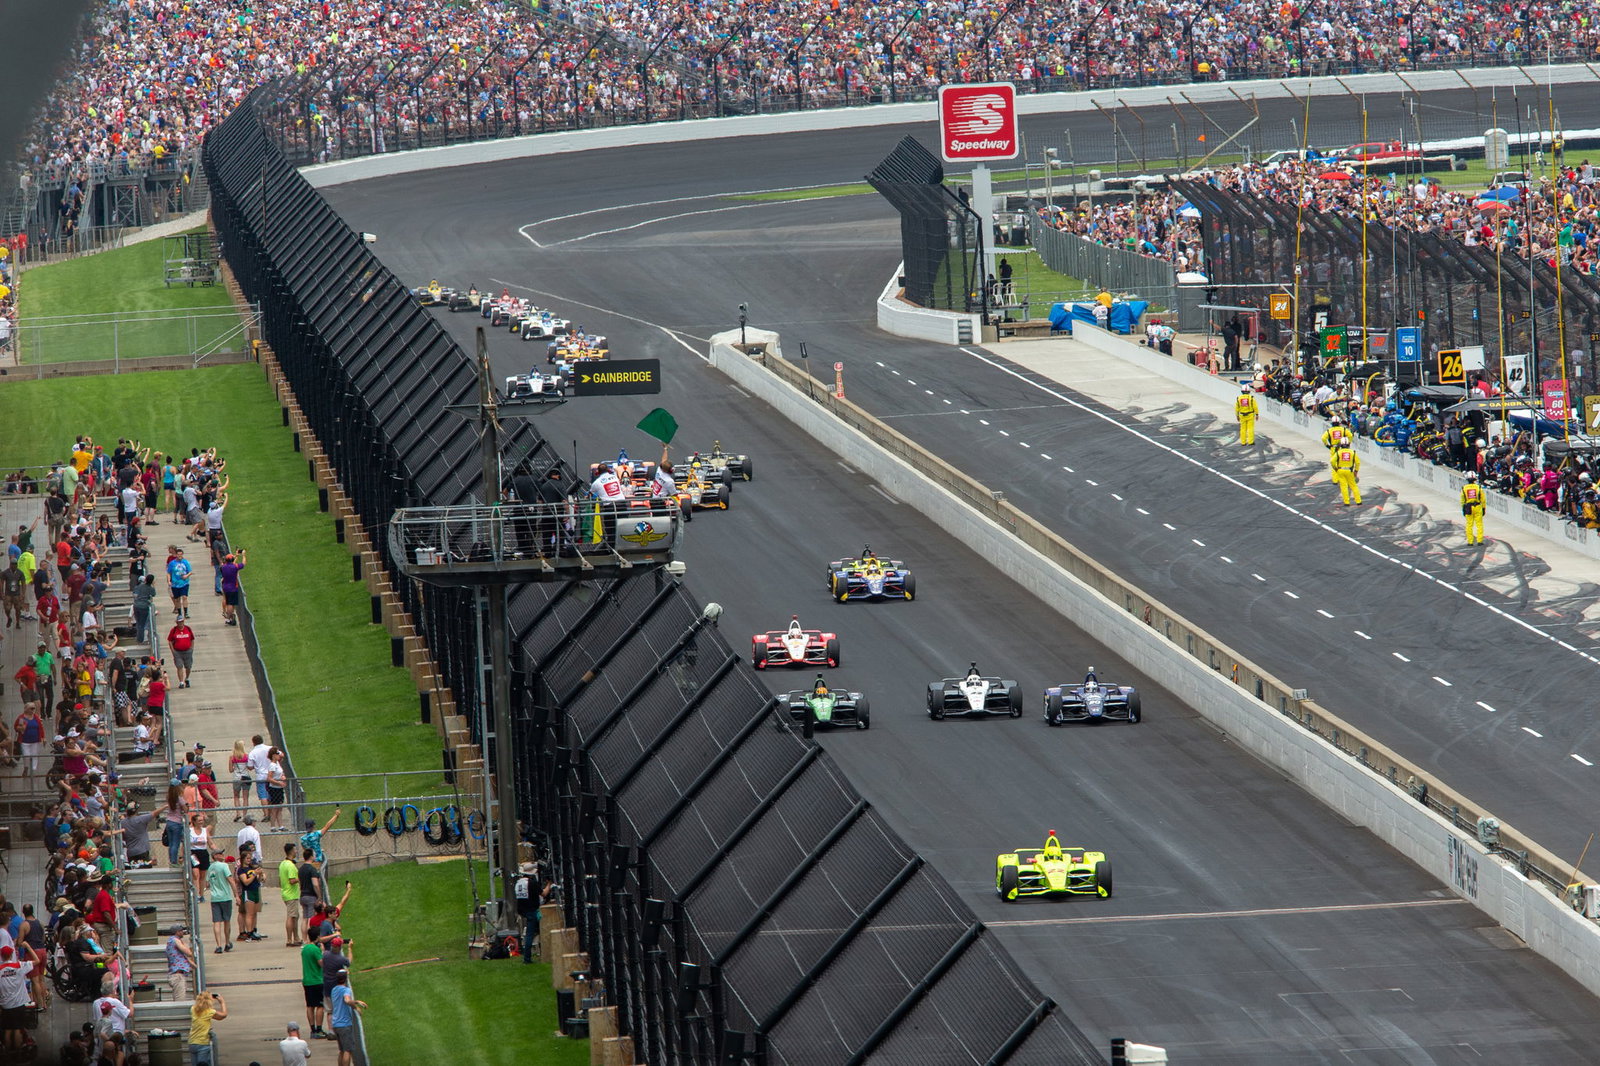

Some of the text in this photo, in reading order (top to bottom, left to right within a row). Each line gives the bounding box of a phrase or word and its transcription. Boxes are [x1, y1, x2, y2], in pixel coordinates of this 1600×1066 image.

[951, 138, 1010, 152] Speedway
[1275, 302, 1287, 311] 24
[1404, 345, 1414, 356] 10
[1442, 355, 1463, 377] 26
[593, 371, 652, 384] GAINBRIDGE
[1509, 367, 1524, 382] 42
[1551, 399, 1563, 409] 60
